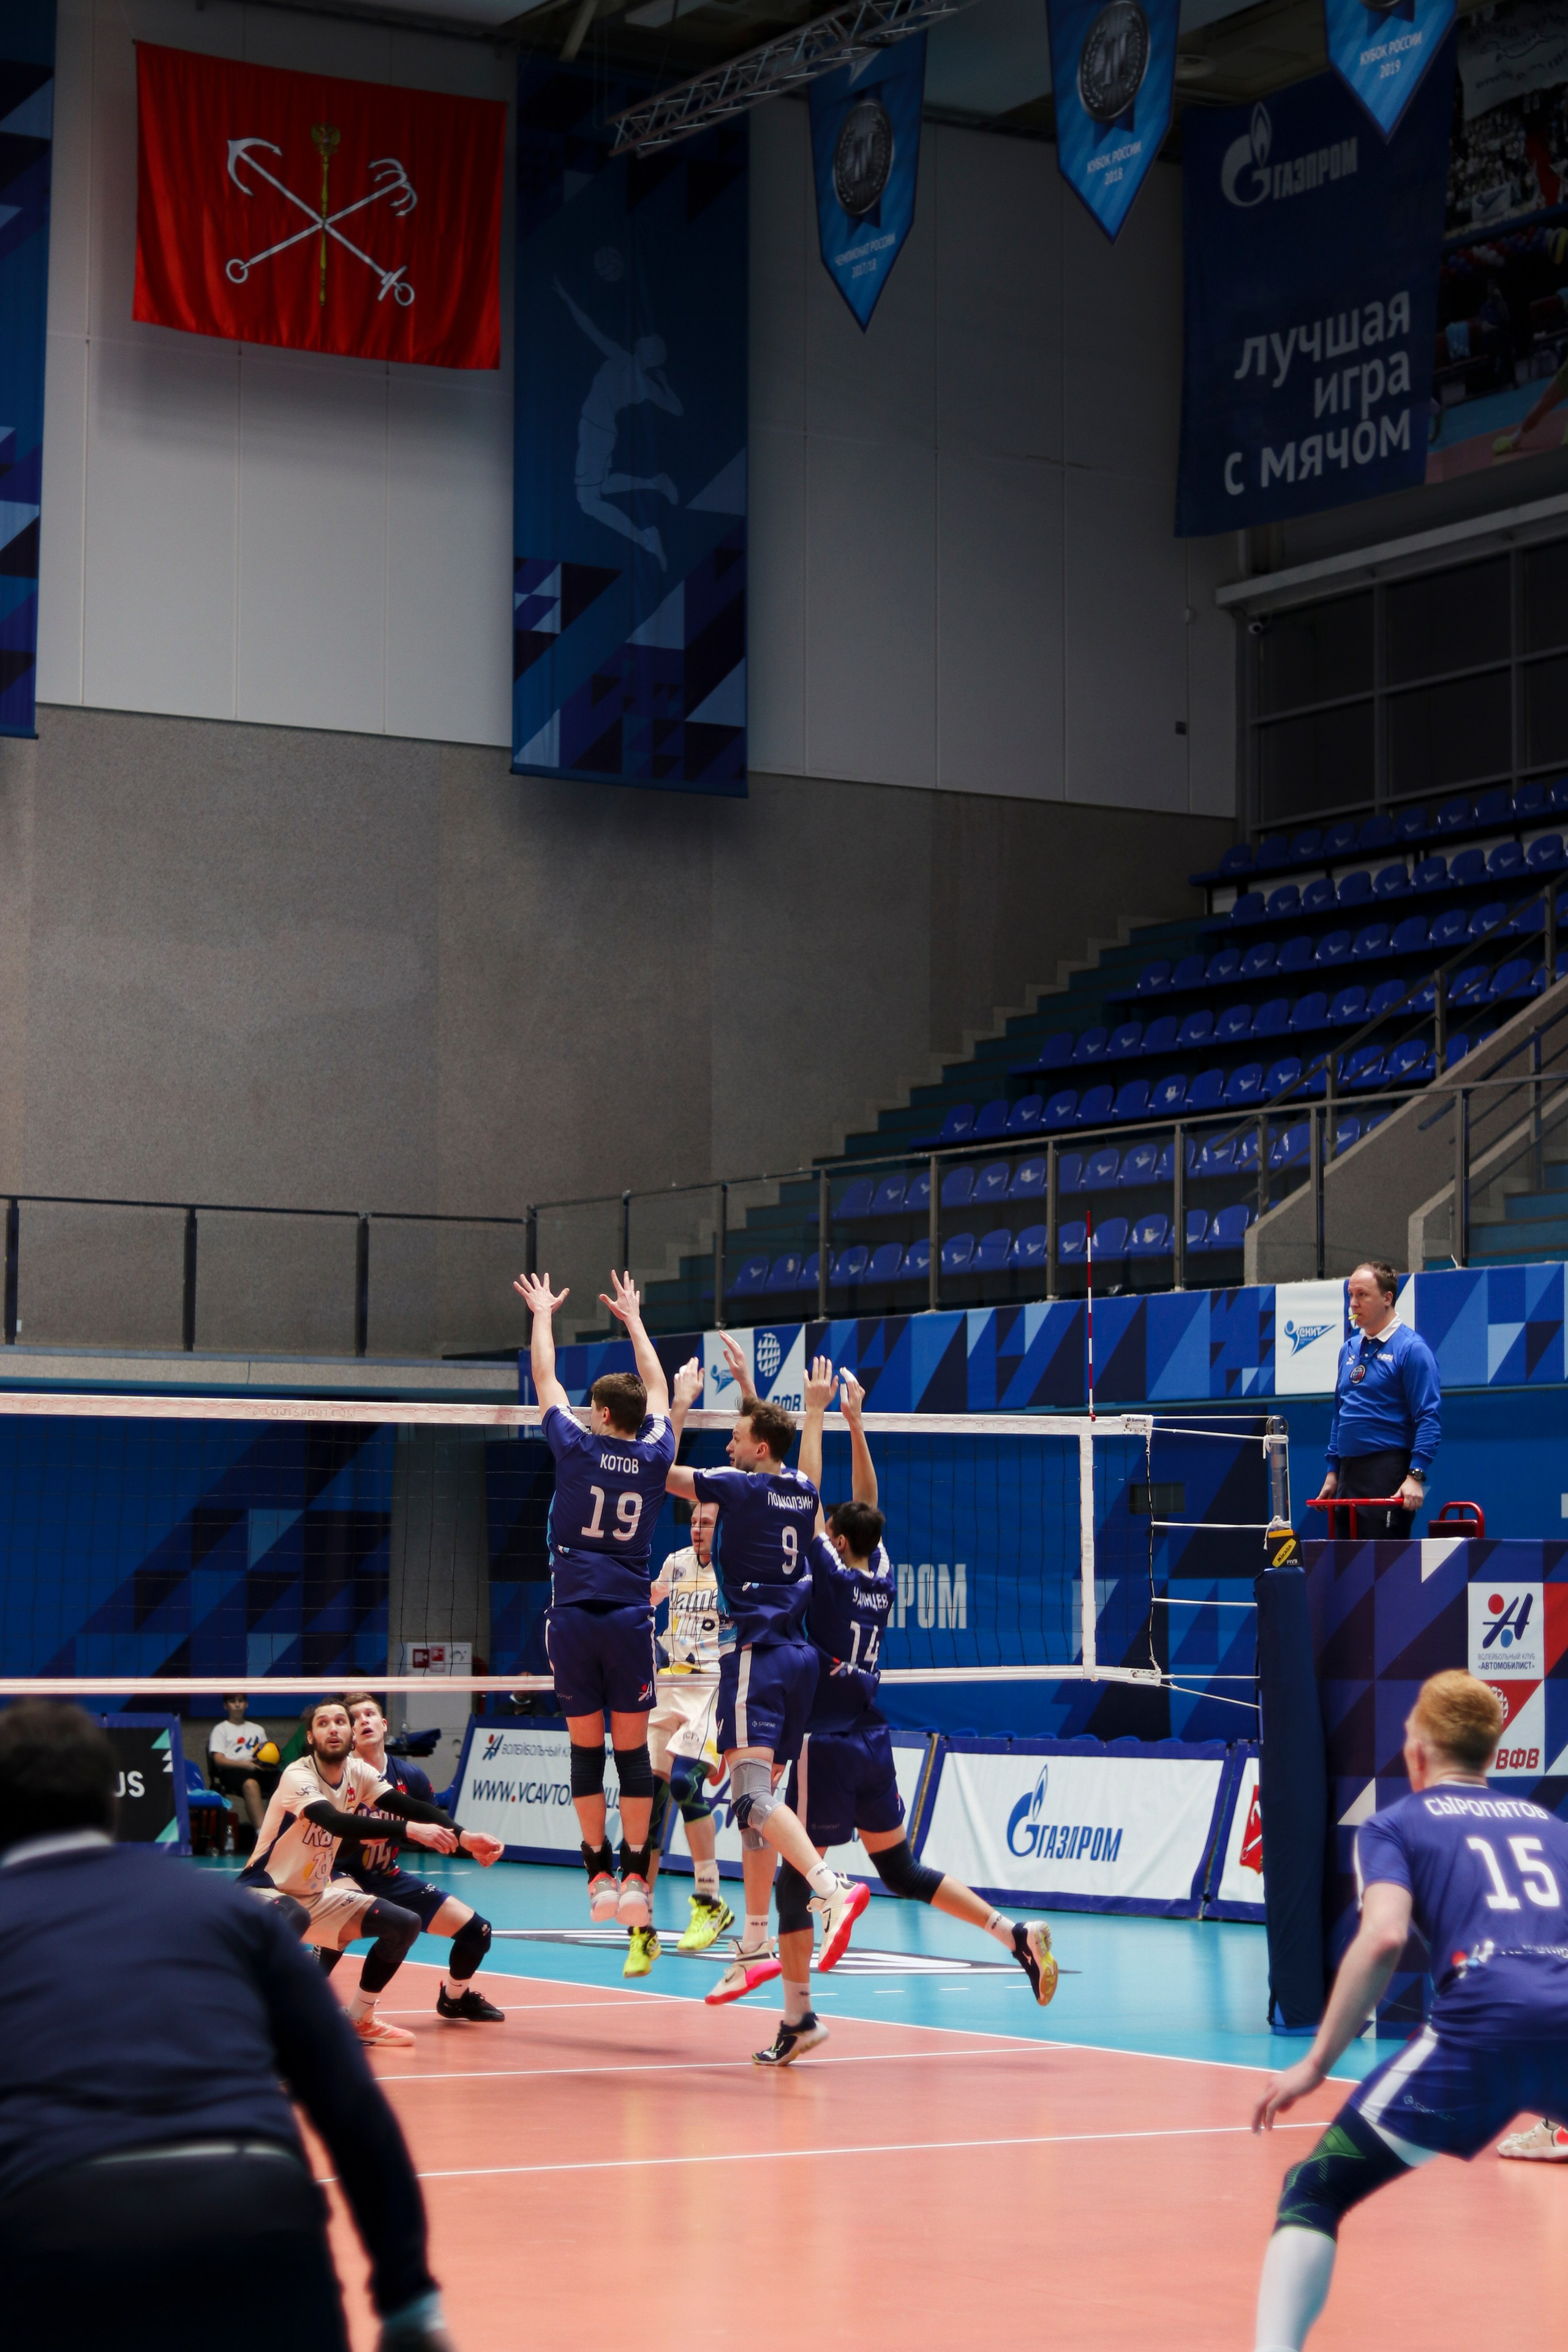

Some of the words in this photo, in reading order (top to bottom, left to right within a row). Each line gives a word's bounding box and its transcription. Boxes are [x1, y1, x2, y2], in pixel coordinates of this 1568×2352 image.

[1360, 43, 1387, 66] КУБОК
[1389, 31, 1422, 55] РОССИИ
[1380, 59, 1401, 79] 2019
[1087, 153, 1111, 174] КУБОК
[1112, 141, 1141, 163] РОССИИ
[1272, 136, 1359, 201] ГАЗПРОМ
[1234, 290, 1411, 389] лучшая
[1314, 350, 1411, 420] игра
[1260, 409, 1411, 489] мячом
[600, 1453, 639, 1474] КОТОВ
[581, 1485, 643, 1541] 19
[767, 1491, 813, 1510] ПОДКОЛЗИН
[782, 1525, 799, 1575] 9
[850, 1620, 879, 1673] 14
[502, 1742, 562, 1757] ВОЛЕЙБОЛЬНЫЙ
[1495, 1747, 1540, 1770] ВФВ
[1423, 1796, 1549, 1820] СЫРОПЯТОВ
[1036, 1825, 1123, 1862] ГАЗПРОМ
[1466, 1835, 1561, 1910] 15
